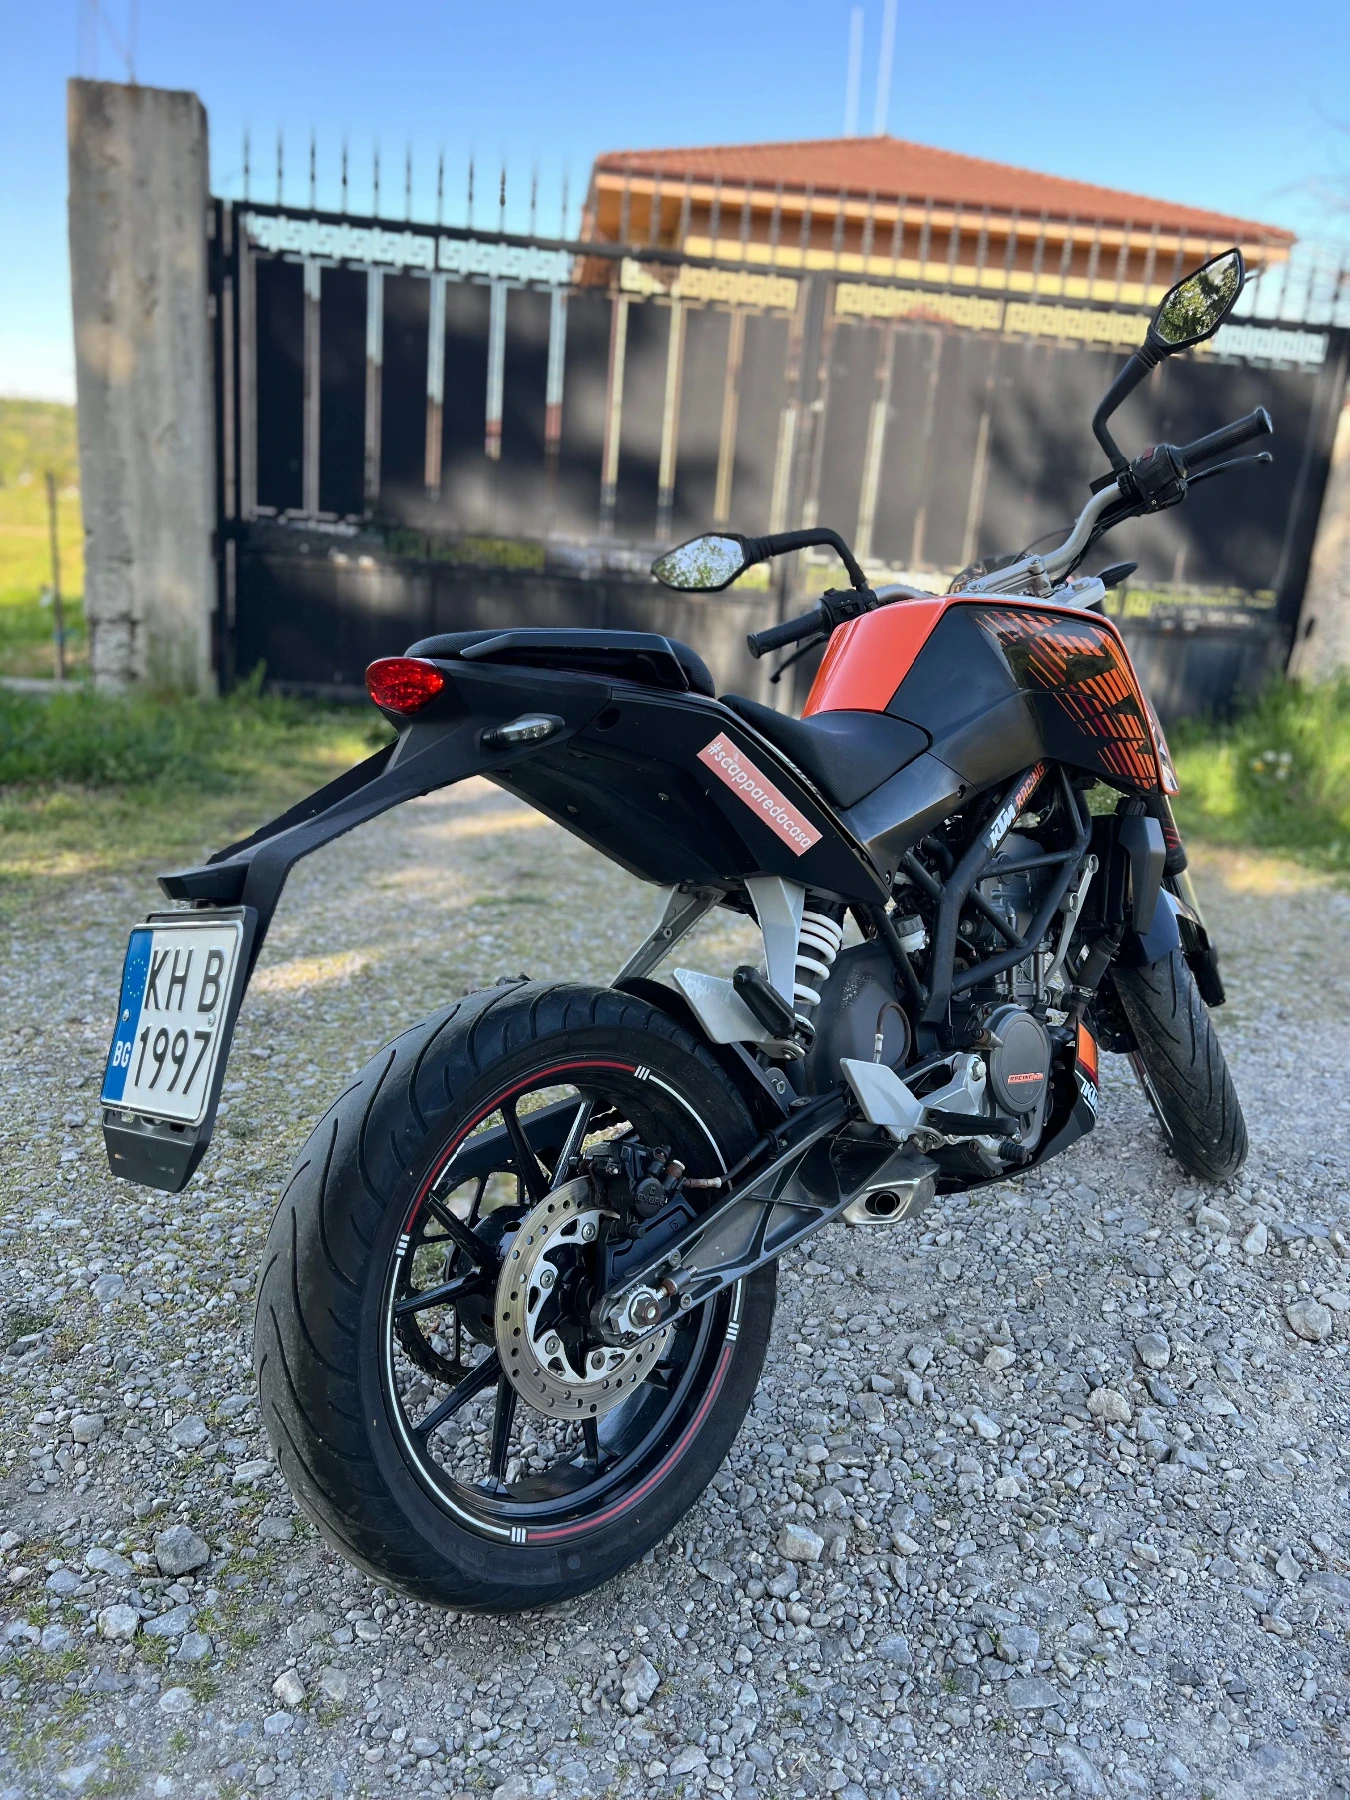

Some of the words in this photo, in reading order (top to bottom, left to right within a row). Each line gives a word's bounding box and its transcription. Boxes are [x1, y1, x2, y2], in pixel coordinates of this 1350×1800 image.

[707, 741, 812, 848] #scapparedacasa
[989, 803, 1016, 849] KTM
[144, 949, 193, 1011] KH
[198, 949, 226, 1013] B
[112, 1040, 131, 1068] BG
[133, 1025, 212, 1095] 1997
